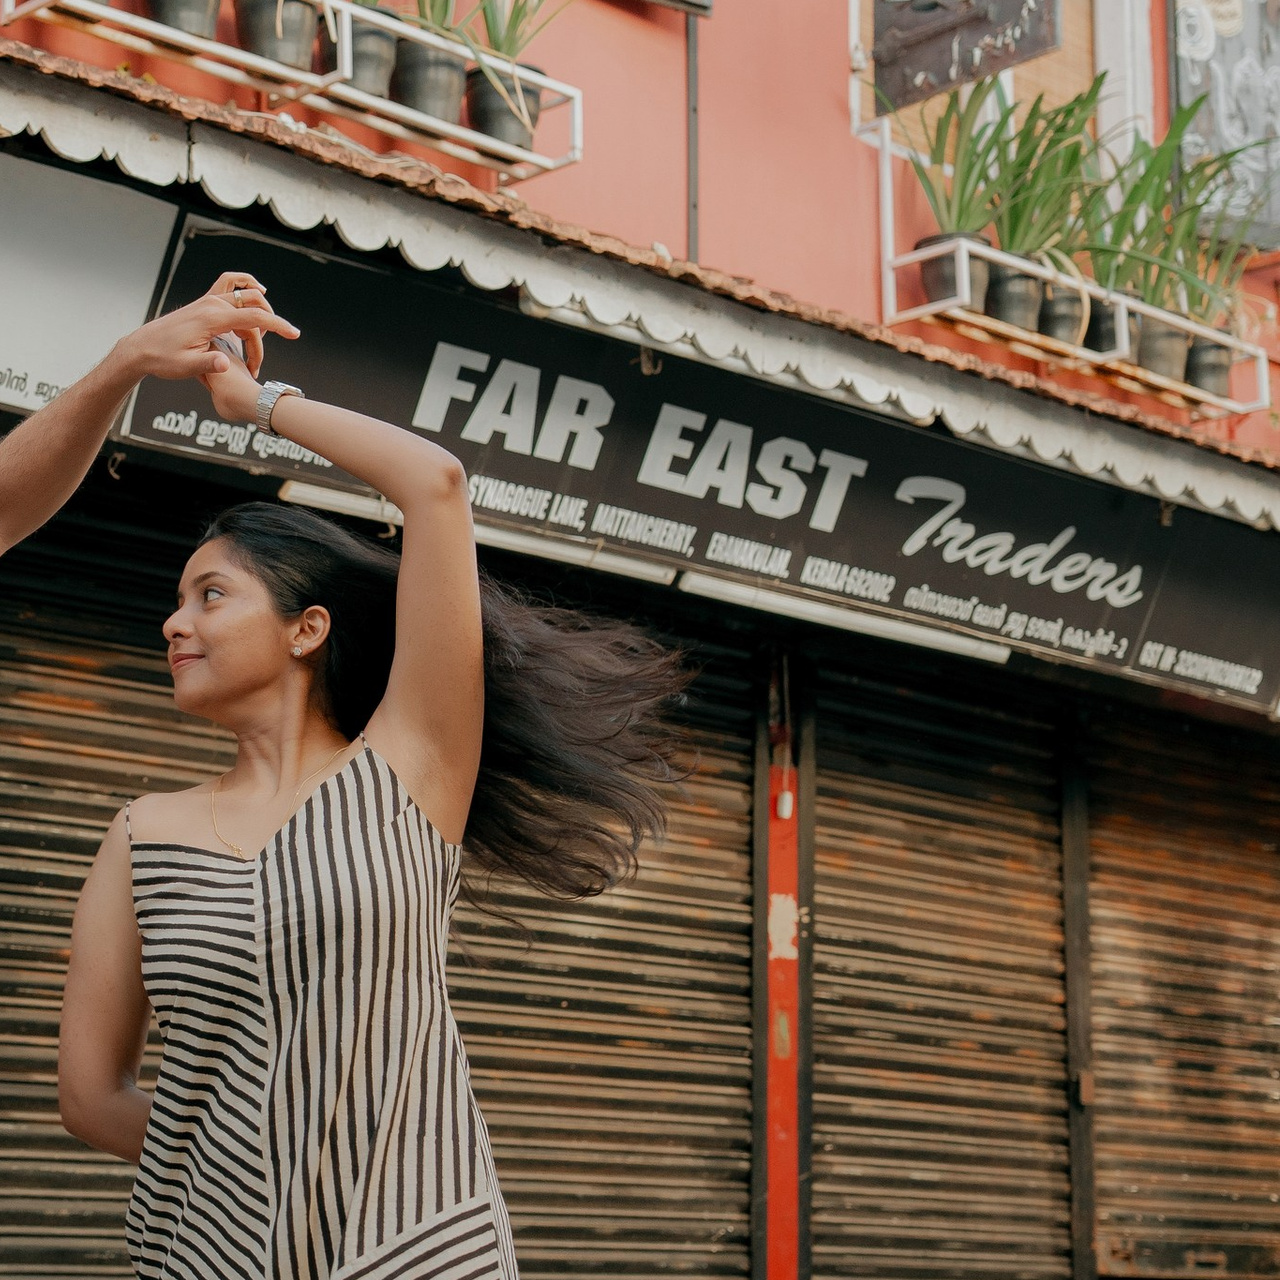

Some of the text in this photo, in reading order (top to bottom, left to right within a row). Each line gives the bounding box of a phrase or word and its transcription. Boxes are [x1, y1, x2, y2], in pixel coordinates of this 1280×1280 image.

[411, 341, 1144, 608] FAR EAST Traders
[469, 474, 553, 520] SYNAGOGUE
[548, 492, 589, 533] LANE,
[590, 503, 698, 559] MATTANCHERRY,
